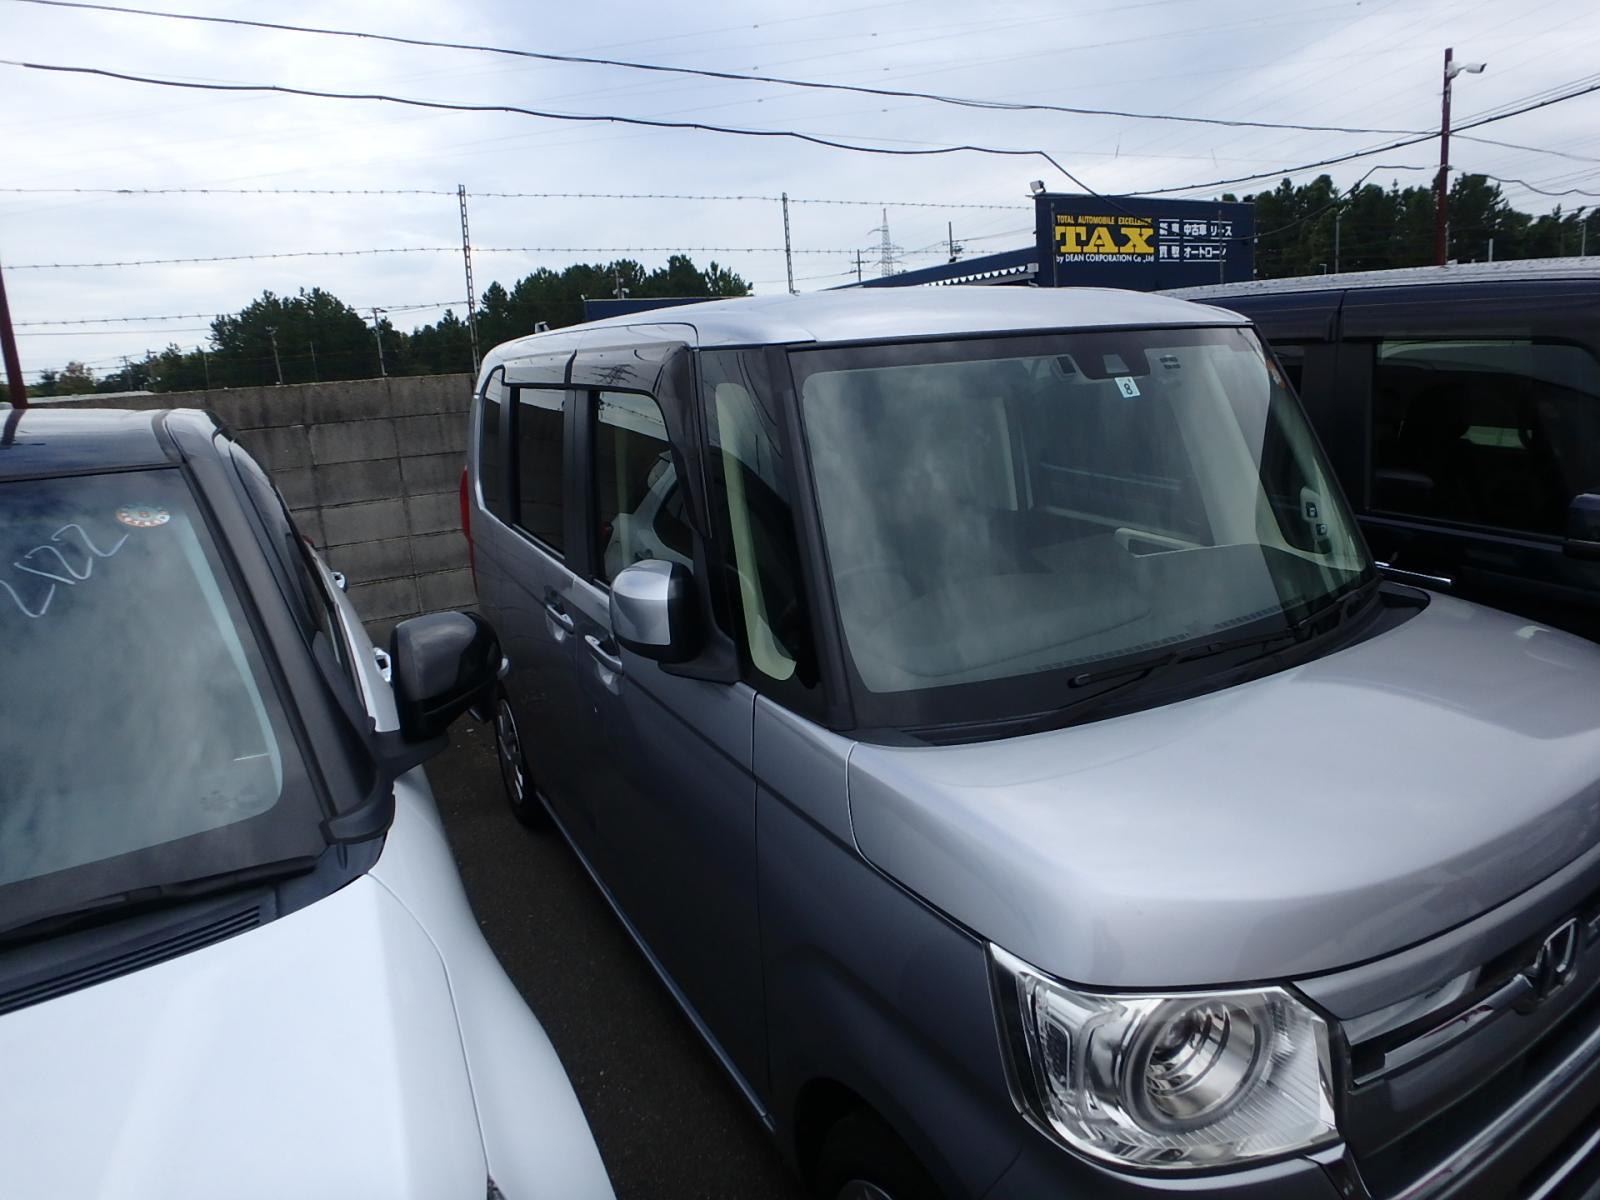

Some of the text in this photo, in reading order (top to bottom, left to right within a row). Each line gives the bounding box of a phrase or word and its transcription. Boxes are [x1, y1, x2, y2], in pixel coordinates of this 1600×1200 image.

[1056, 215, 1075, 224] TOTAL
[1078, 215, 1115, 225] AUTOMOBILE
[1183, 223, 1207, 236] 中古車
[1055, 226, 1155, 253] TAX
[1056, 255, 1064, 264] by
[1065, 253, 1084, 262] DEAN
[1085, 253, 1132, 263] CORPORATION
[1123, 383, 1133, 395] 8
